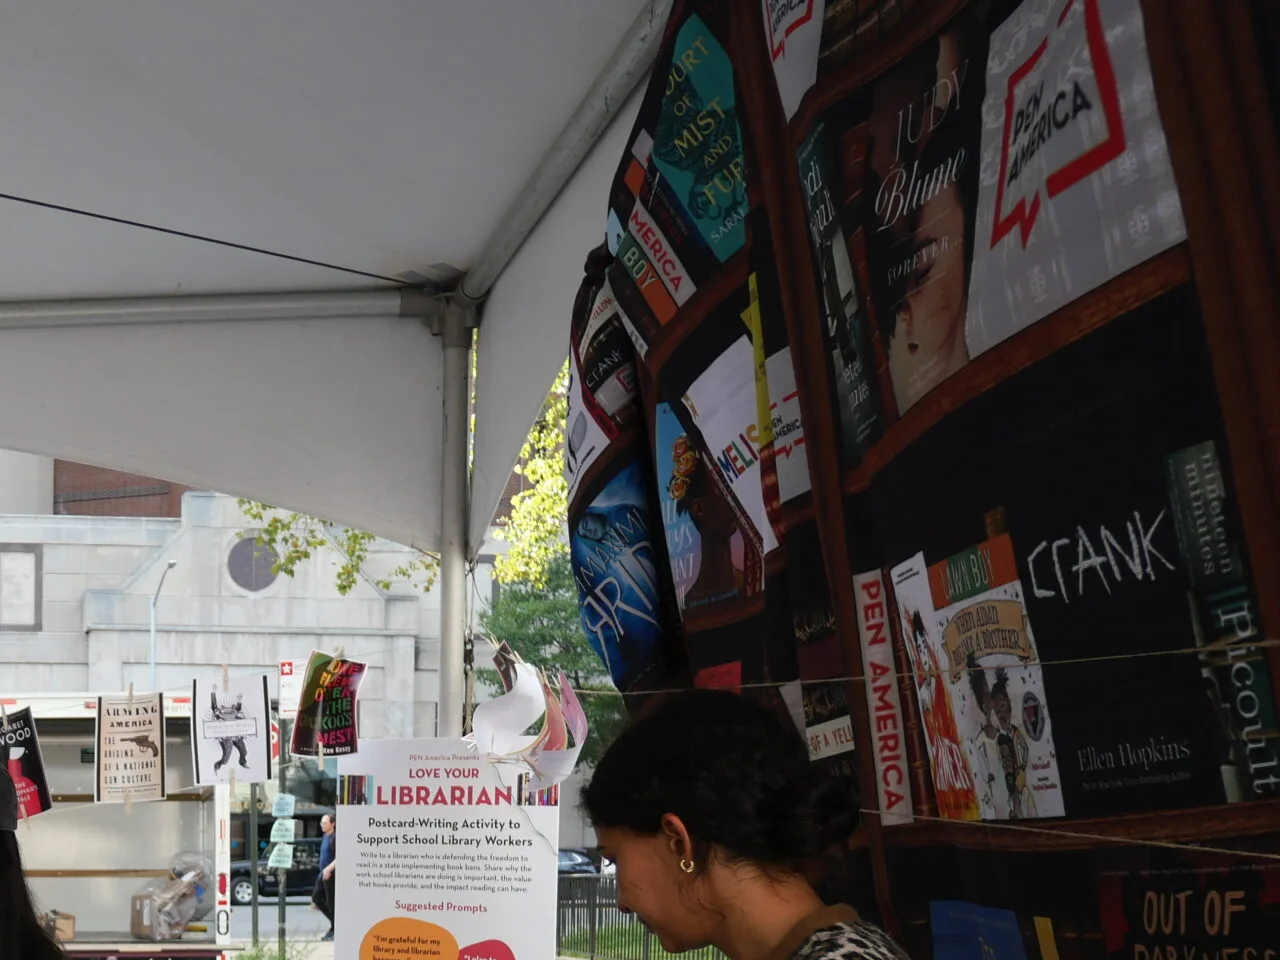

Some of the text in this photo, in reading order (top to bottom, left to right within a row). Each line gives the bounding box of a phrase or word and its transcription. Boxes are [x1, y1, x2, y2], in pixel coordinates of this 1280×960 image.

[673, 91, 693, 116] OF
[893, 58, 971, 167] JUDY
[1014, 83, 1044, 142] PEN
[674, 96, 727, 158] MIST
[1007, 82, 1092, 187] AMERICA
[703, 135, 732, 169] AND
[875, 146, 966, 234] Blume
[631, 210, 682, 292] MERICA
[624, 246, 656, 288] BOY
[1185, 461, 1217, 576] minutes
[1201, 452, 1233, 576] nineteen
[940, 547, 995, 600] LAWN BOY
[982, 628, 1020, 650] BROTHER
[862, 580, 905, 810] PEN AMERICA
[1218, 603, 1280, 794] Picoult
[105, 706, 157, 717] ARMING
[110, 719, 153, 728] AMERICA
[316, 728, 353, 744] NEST
[811, 736, 821, 751] OF
[104, 750, 134, 758] ORIGINS
[1077, 735, 1191, 772] Ellen Hopkins
[123, 760, 157, 770] NATIONAL
[409, 769, 479, 778] LOVE YOUR
[122, 774, 151, 784] CULTURE
[377, 786, 512, 805] LIBRARIAN
[369, 818, 520, 831] Postcard-Writing Activity to
[357, 834, 532, 847] Support School Library Workers
[402, 863, 445, 871] implementing
[442, 853, 475, 862] defending
[438, 873, 455, 881] doing
[396, 901, 487, 914] Suggested Prompts
[1143, 889, 1247, 936] OUT OF
[387, 936, 416, 944] grateful
[373, 946, 395, 954] library
[411, 947, 440, 955] librarian
